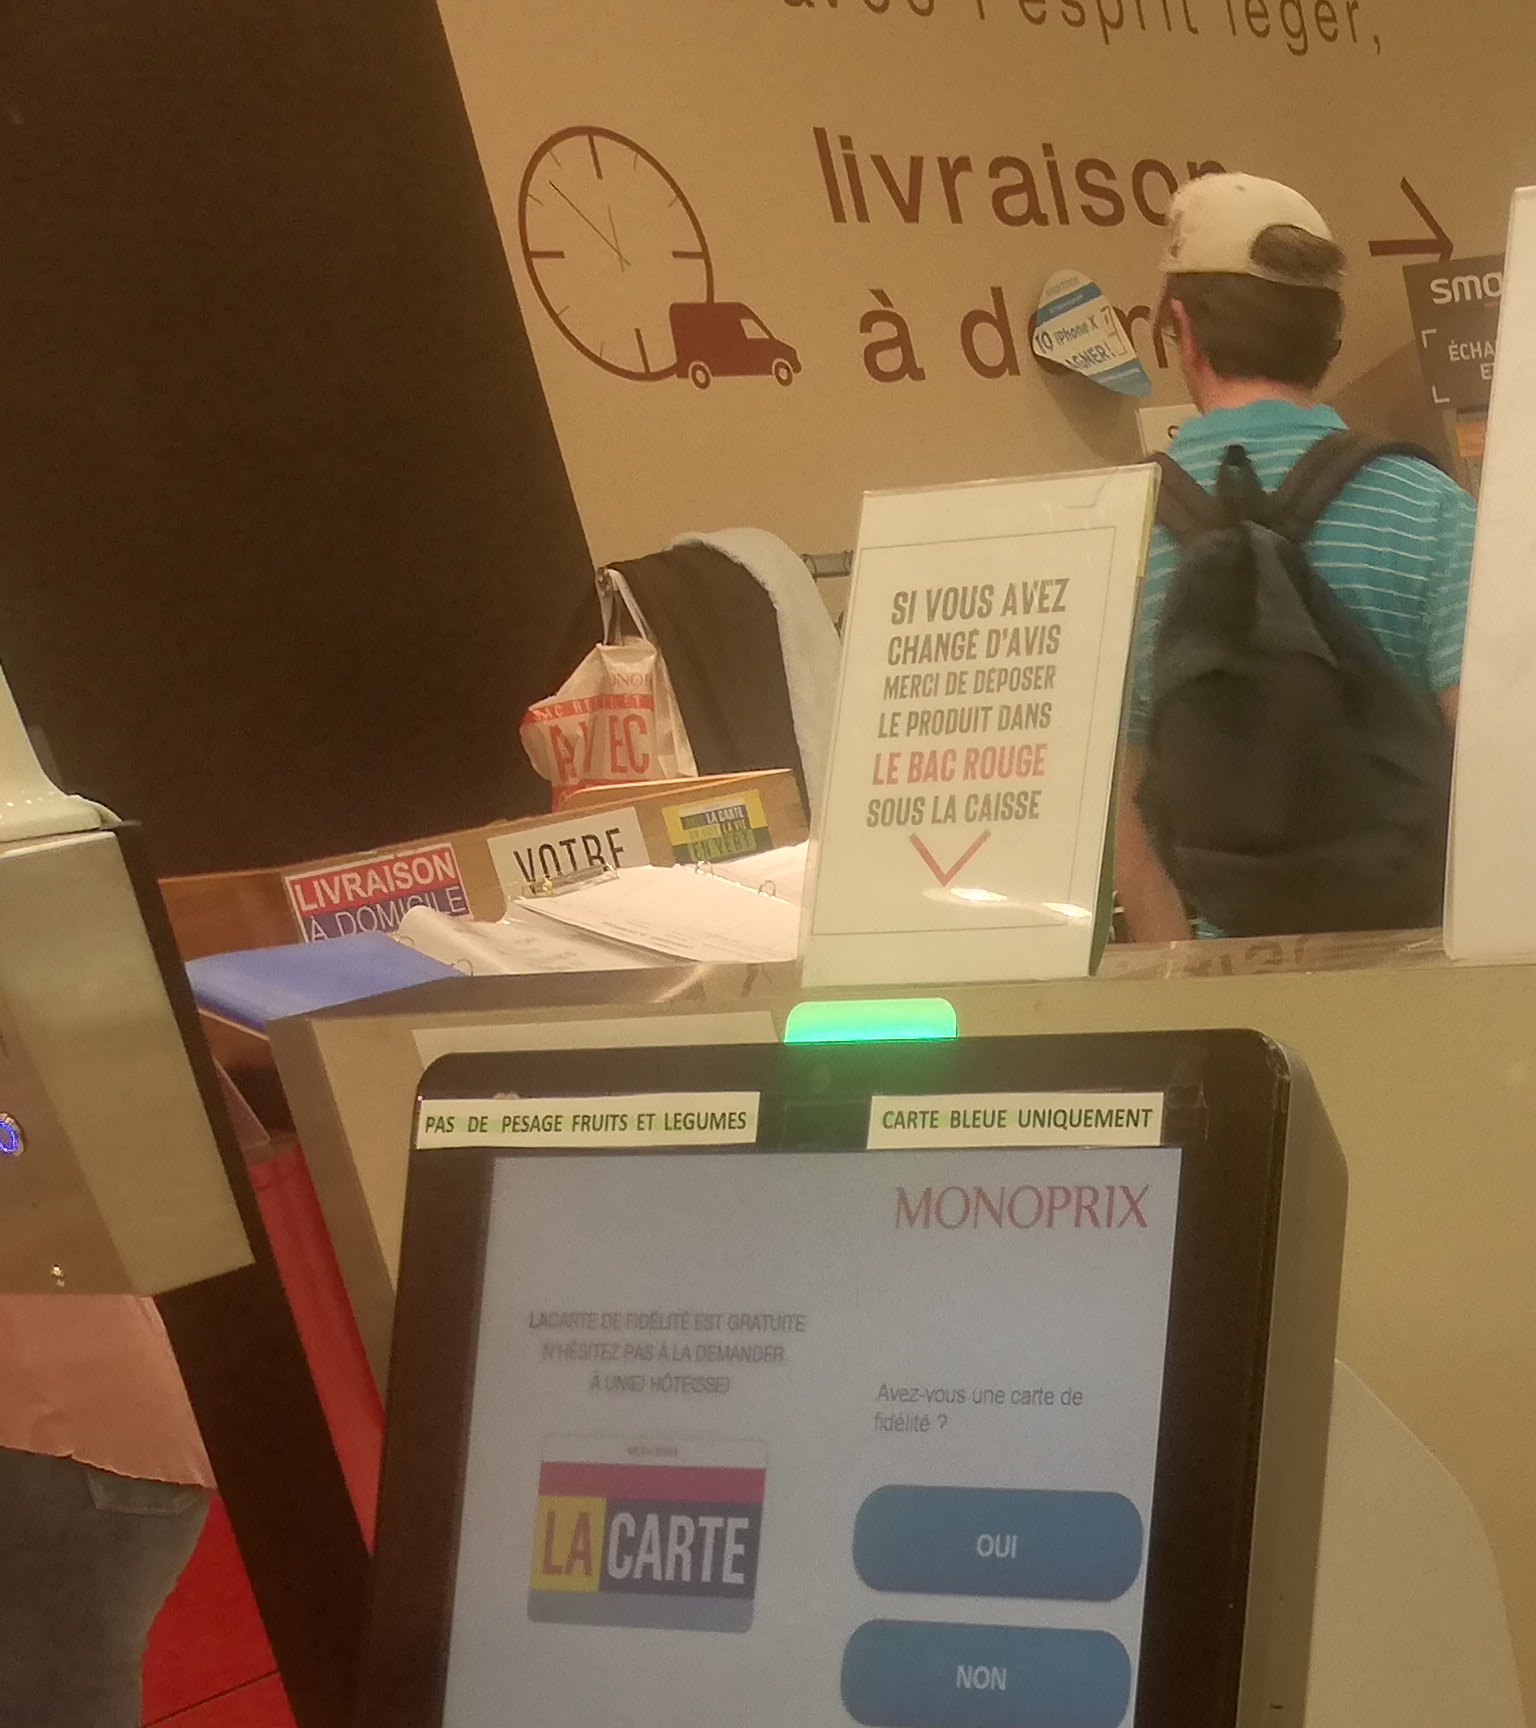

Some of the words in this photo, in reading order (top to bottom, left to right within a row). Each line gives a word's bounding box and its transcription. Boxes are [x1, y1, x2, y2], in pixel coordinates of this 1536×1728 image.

[1430, 271, 1502, 305] smo
[858, 289, 926, 383] à
[1448, 340, 1498, 361] ÉCHA
[891, 591, 917, 625] SI
[926, 584, 995, 623] VOUS
[1000, 578, 1069, 617] AVEZ
[887, 628, 979, 666] CHANGÉ
[985, 624, 1061, 659] D'AVIS
[883, 672, 939, 700] MERCI
[945, 670, 968, 696] DE
[973, 665, 1056, 694] DÉPOSER
[878, 712, 901, 738] LE
[906, 705, 993, 737] PRODUIT
[997, 702, 1053, 731] DANS
[872, 752, 901, 785] LE
[907, 749, 957, 784] BAC
[962, 743, 1048, 780] ROUGE
[866, 796, 926, 827] SOUS
[930, 795, 957, 824] LA
[964, 790, 1042, 823] CAISSE
[513, 828, 625, 894] VOTRE
[296, 851, 456, 911] LIVRAISON
[424, 1114, 455, 1134] PAS
[467, 1115, 489, 1134] DE
[501, 1114, 564, 1133] PESAGE
[571, 1113, 629, 1132] FRUITS
[636, 1113, 656, 1131] ET
[663, 1110, 748, 1131] LEGUMES
[882, 1110, 940, 1129] CARTE
[949, 1109, 1008, 1129] BLEUE
[1017, 1108, 1154, 1131] UNIQUEMENT
[895, 1184, 1150, 1231] MONOPRIX
[541, 1508, 594, 1578] LA
[607, 1510, 750, 1586] CARTE
[975, 1532, 1018, 1560] OUI
[955, 1664, 1008, 1692] NON
